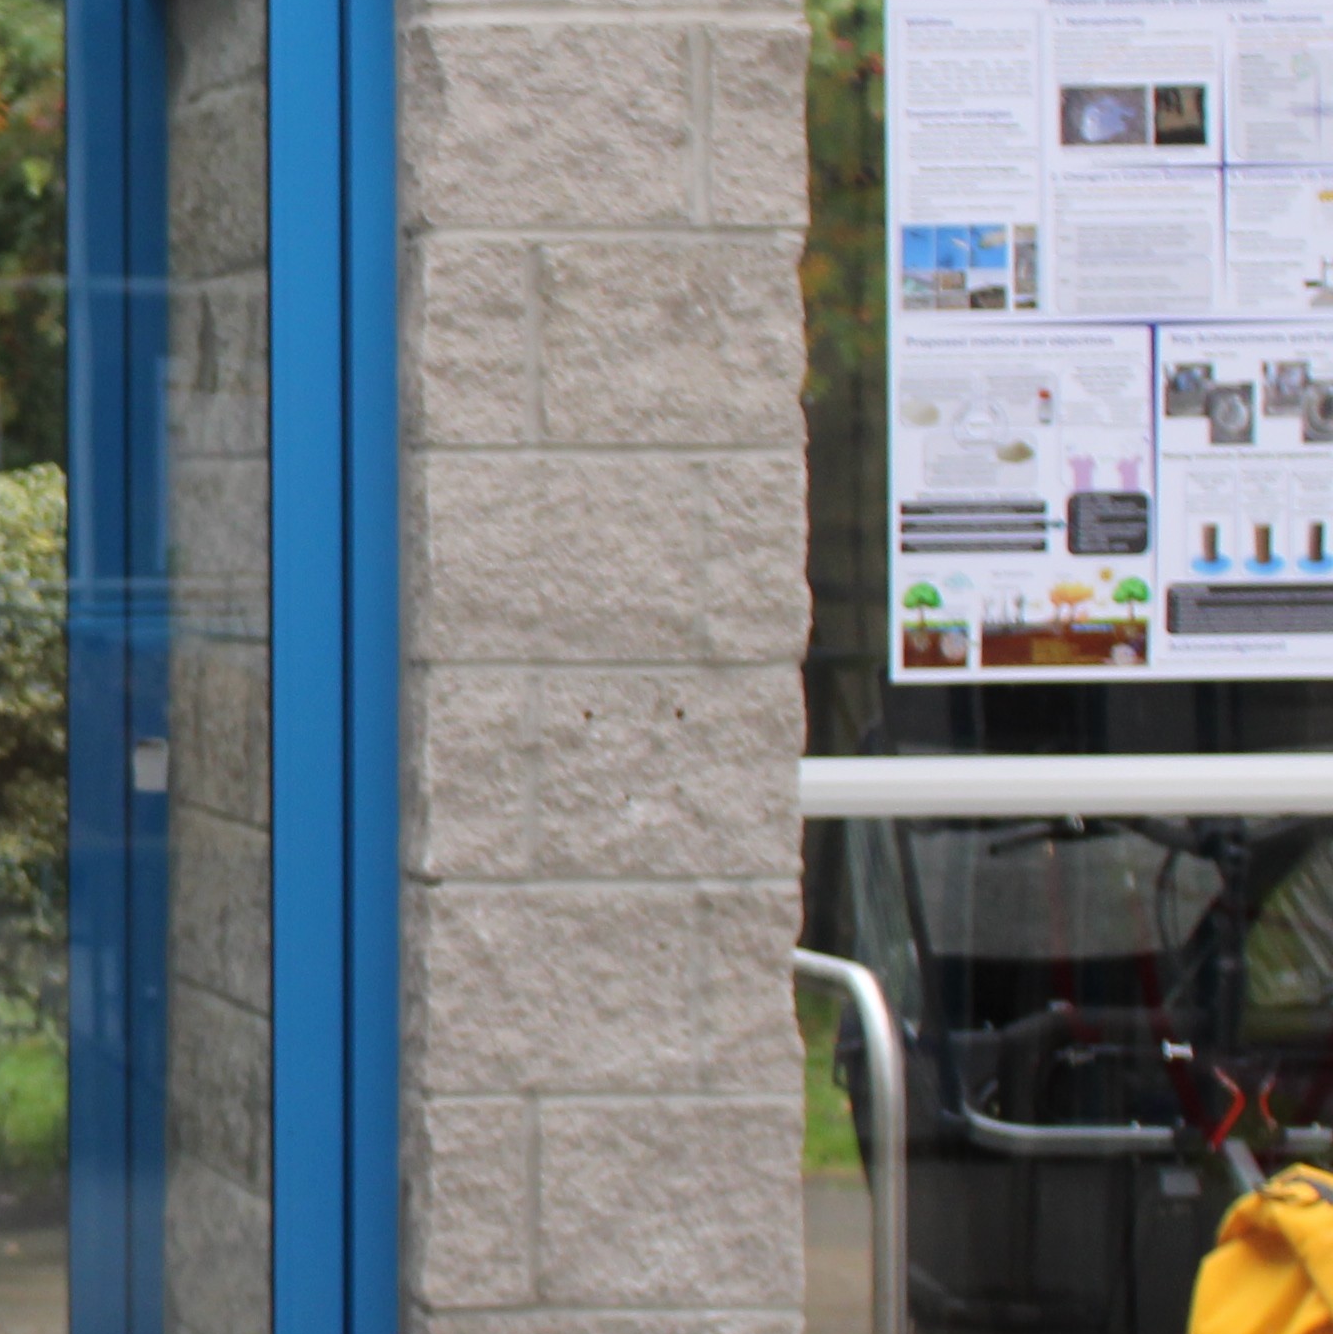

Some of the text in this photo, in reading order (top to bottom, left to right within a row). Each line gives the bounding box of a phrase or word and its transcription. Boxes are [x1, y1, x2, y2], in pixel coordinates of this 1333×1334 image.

[906, 334, 1114, 349] Proposed method and objectives
